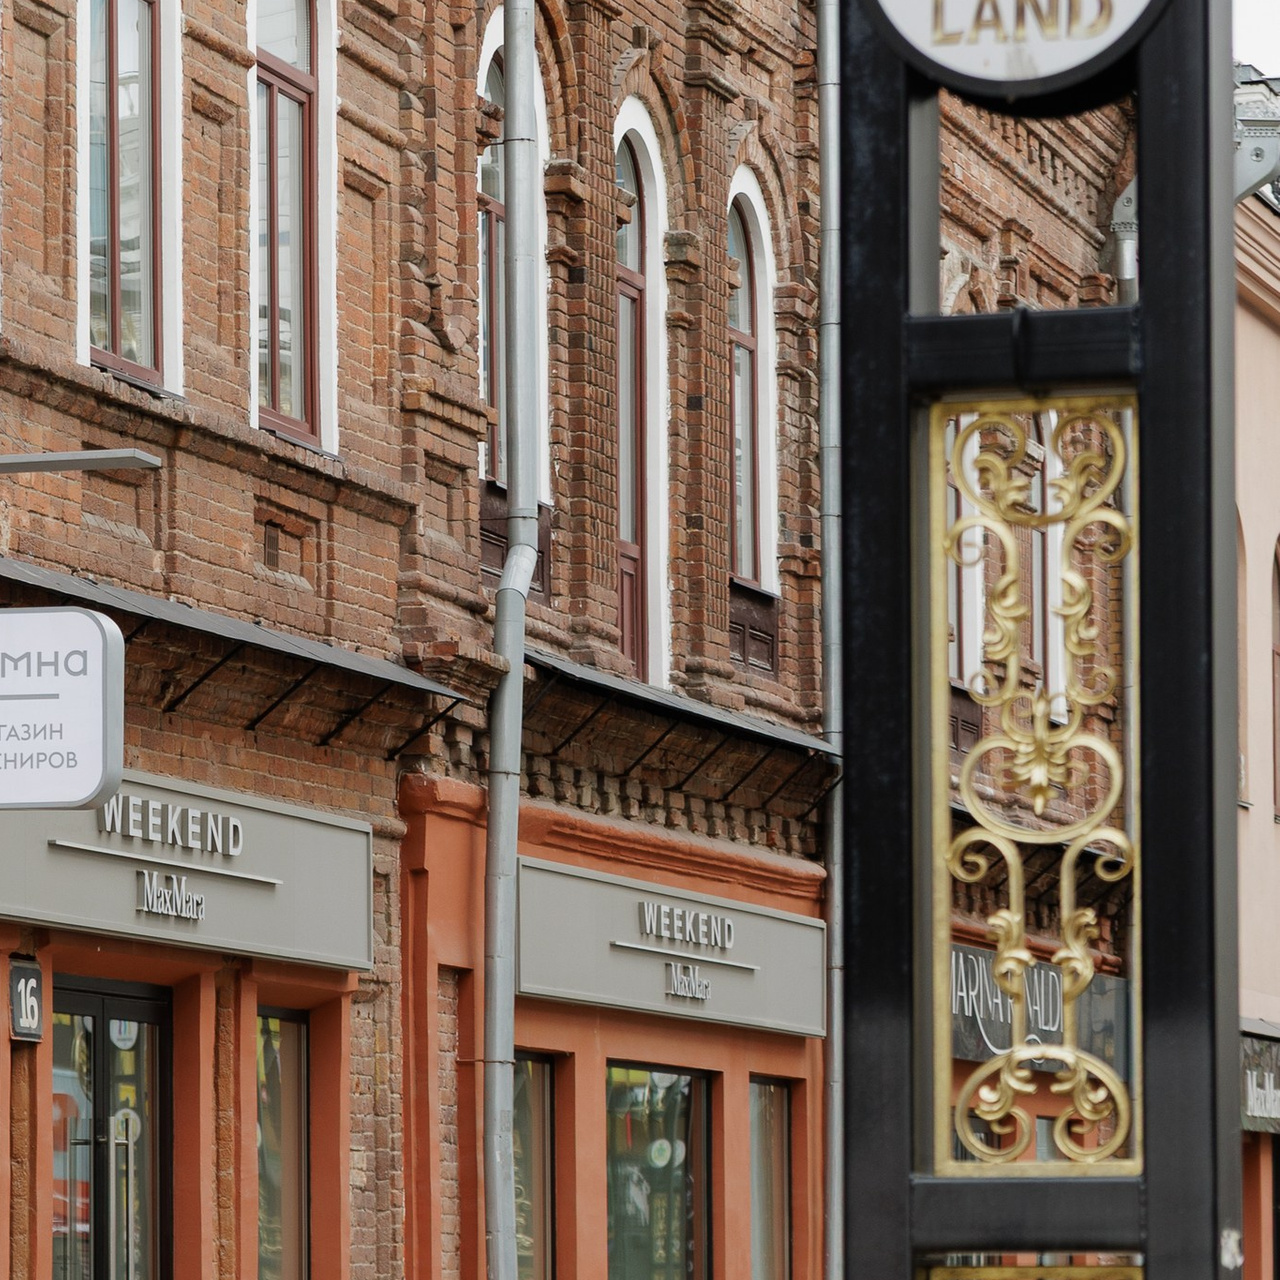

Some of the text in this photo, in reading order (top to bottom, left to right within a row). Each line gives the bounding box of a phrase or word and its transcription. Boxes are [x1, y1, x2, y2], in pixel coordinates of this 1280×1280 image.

[97, 793, 244, 857] WEEKEND
[136, 869, 206, 921] MaxMara
[638, 900, 736, 949] WEEKEND
[17, 976, 40, 1030] 16
[665, 961, 712, 1000] MaxMara
